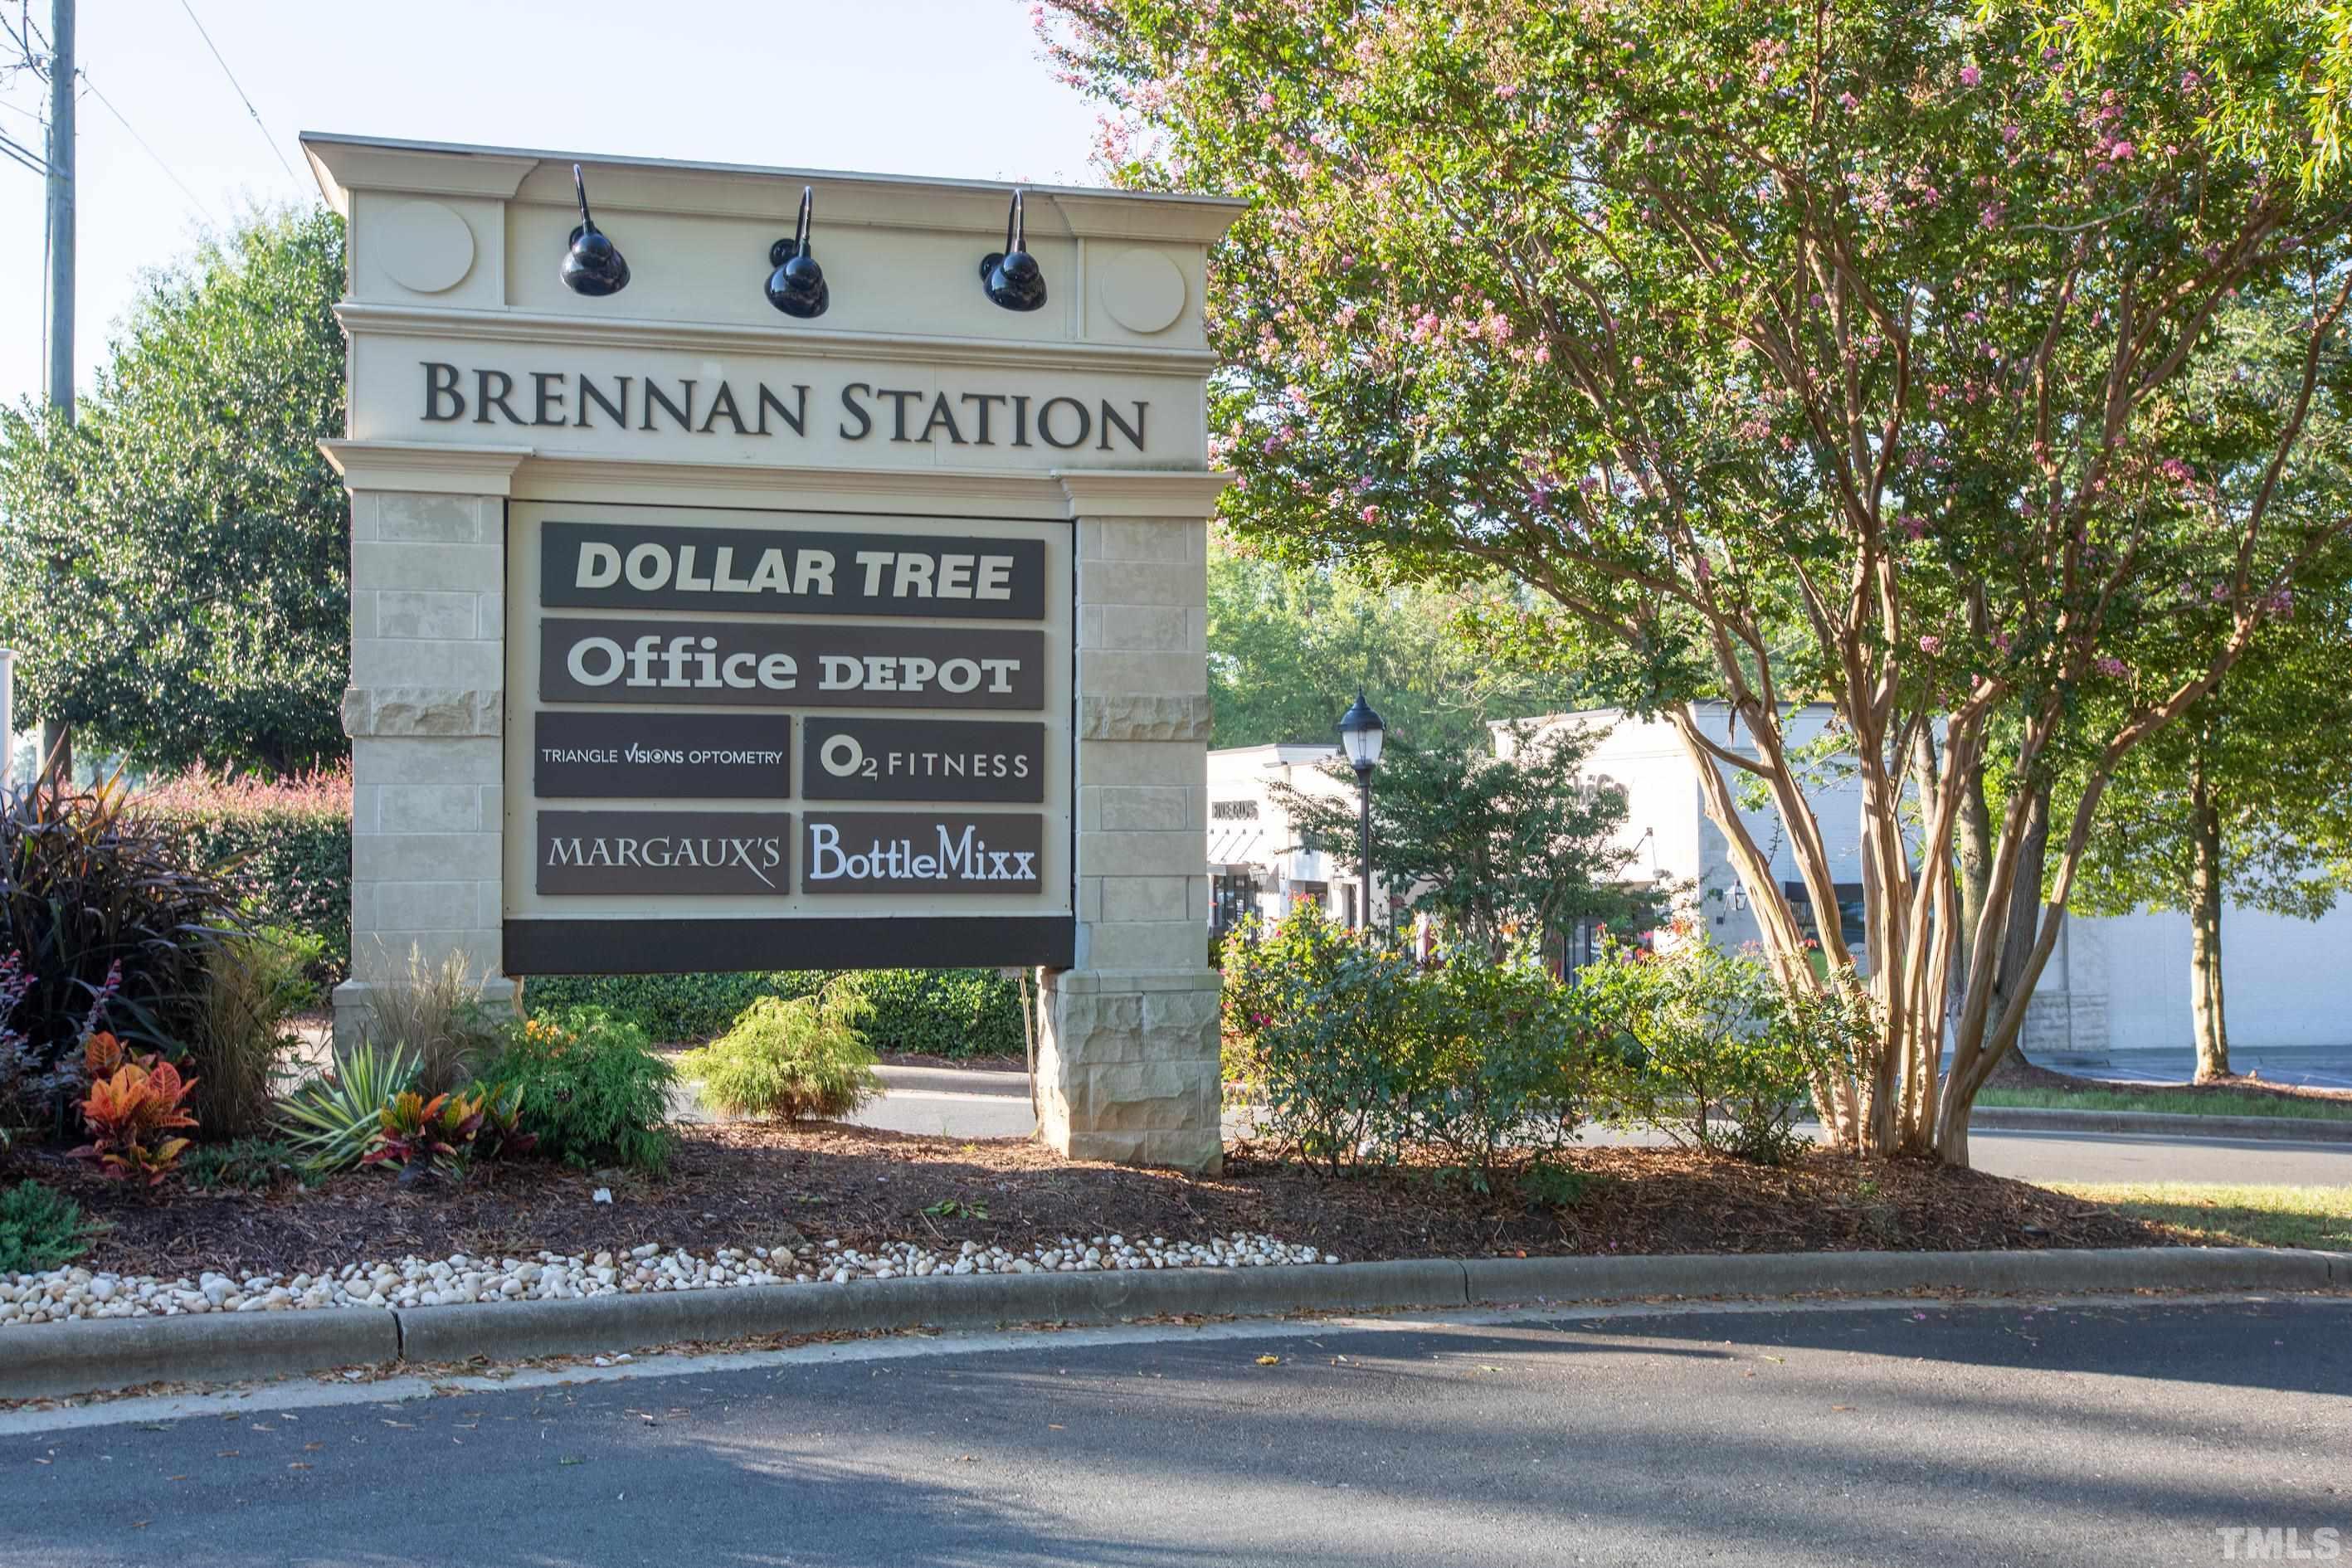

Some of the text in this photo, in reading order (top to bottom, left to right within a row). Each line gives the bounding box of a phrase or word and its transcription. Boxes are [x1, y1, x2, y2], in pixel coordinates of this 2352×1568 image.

[419, 360, 1149, 453] BRENNAN STATION
[576, 541, 1014, 599] DOLLAR TREE
[567, 635, 1020, 693] Office DEPOT
[543, 743, 782, 764] TRIANGLE VISIONS OPTOMETRY
[889, 752, 1029, 778] FITNESS
[548, 836, 780, 889] MARGAUX'S
[810, 824, 1037, 880] BottleMixx
